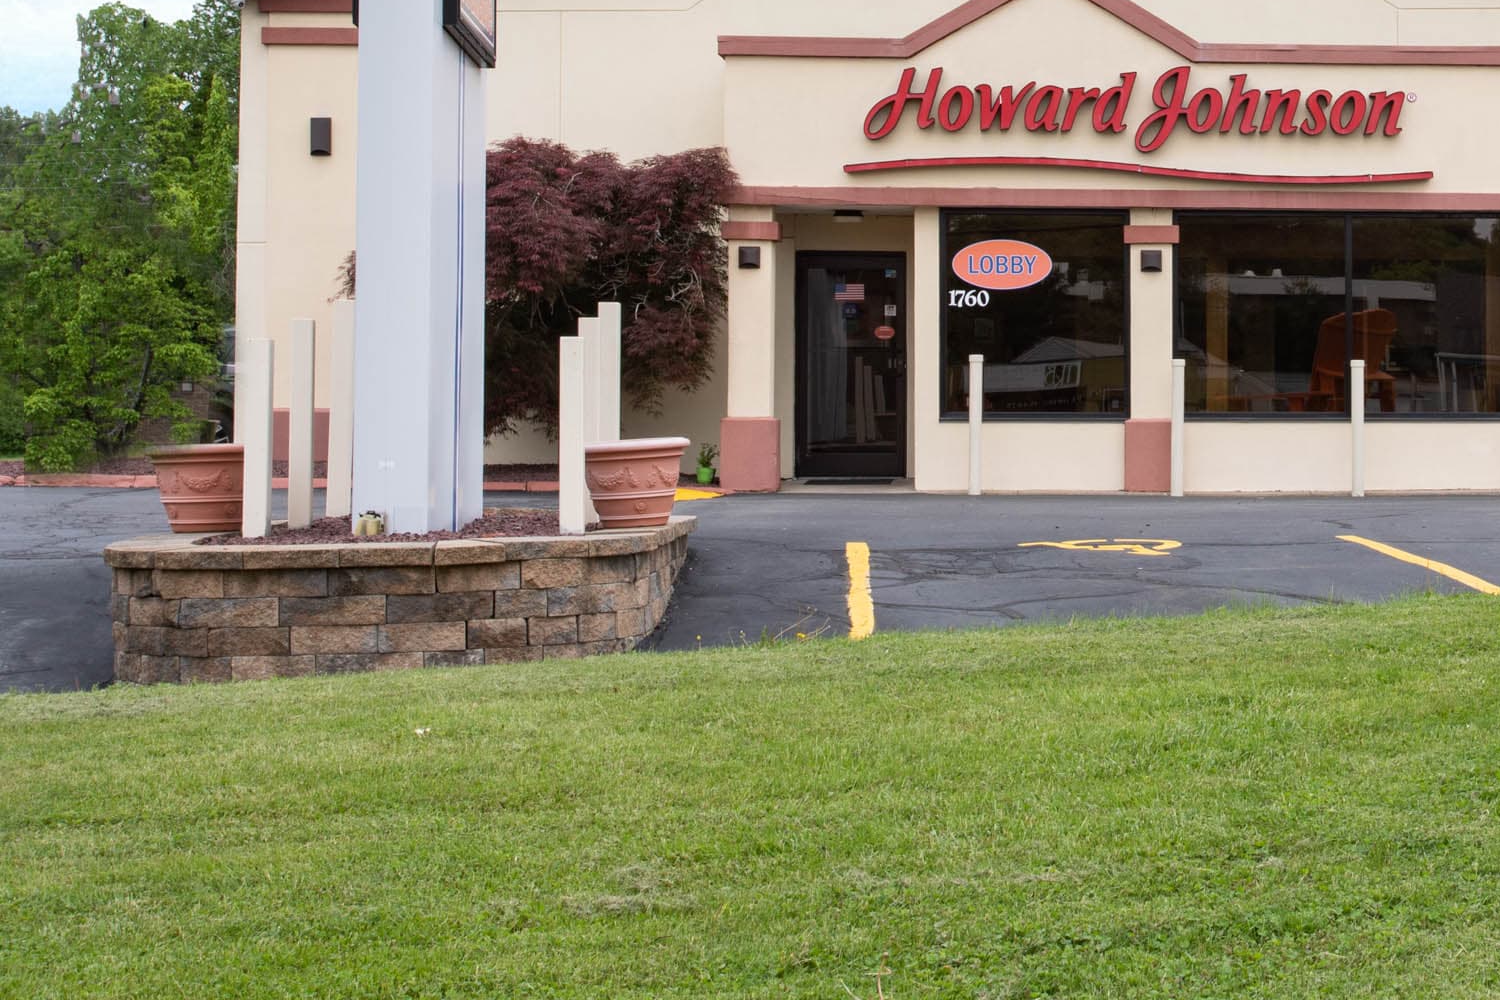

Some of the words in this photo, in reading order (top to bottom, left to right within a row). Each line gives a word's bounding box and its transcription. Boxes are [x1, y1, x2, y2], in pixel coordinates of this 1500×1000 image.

[863, 67, 1138, 141] Howard
[1134, 66, 1406, 153] Johnson
[968, 255, 1037, 275] LOBBY
[948, 289, 990, 308] 1760
